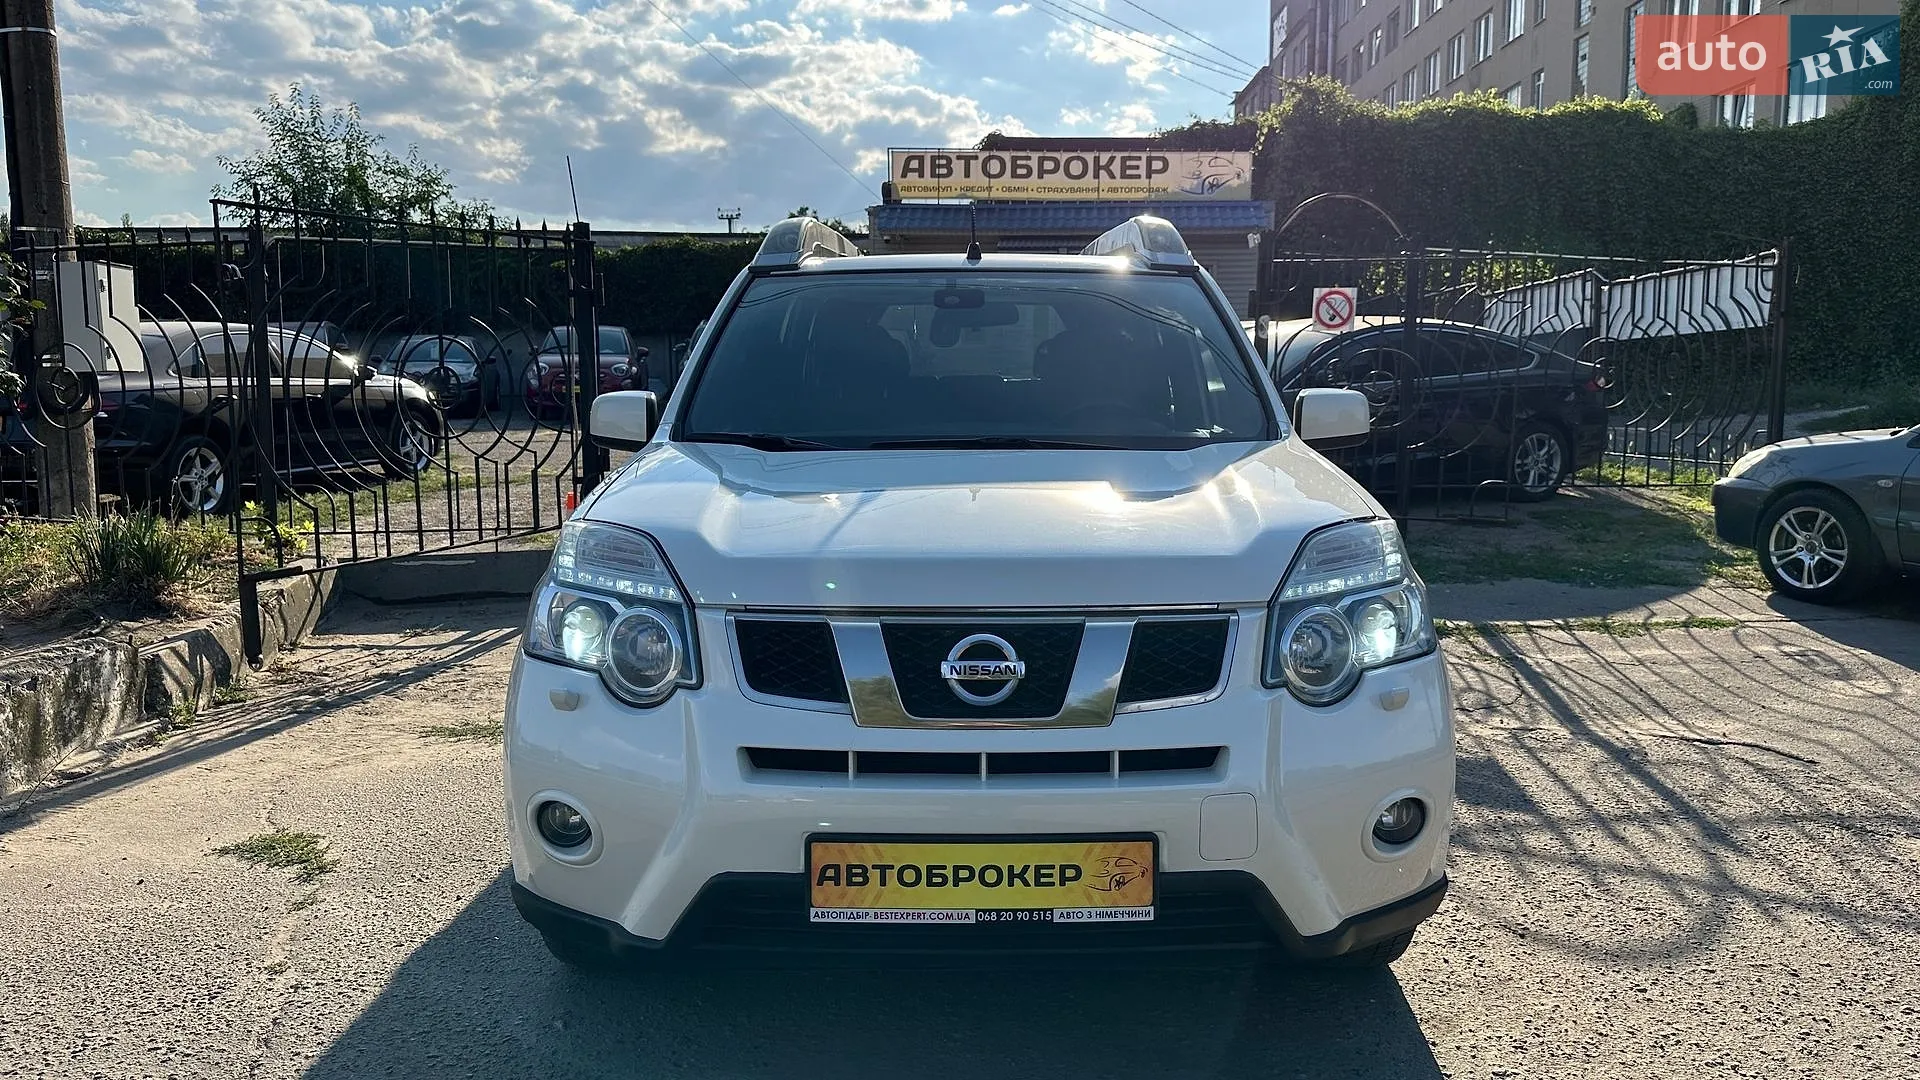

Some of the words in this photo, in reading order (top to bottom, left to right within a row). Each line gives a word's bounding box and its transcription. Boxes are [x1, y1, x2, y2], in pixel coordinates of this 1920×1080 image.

[900, 154, 1170, 180] АВТОБРОКЕР
[900, 185, 952, 193] АВТОВИКУП
[959, 185, 994, 193] КРЕДИТ
[1036, 186, 1099, 194] СТРАХУВАННЯ
[1106, 186, 1169, 194] АВТОПРОДАЖ
[949, 664, 1017, 676] NISSAN
[816, 863, 1083, 888] АВТОБРОКЕР
[977, 911, 998, 921] 068
[1000, 911, 1014, 921] 20
[1016, 911, 1030, 921] 90
[1032, 911, 1052, 921] 515
[1058, 910, 1084, 920] АВТО
[1096, 909, 1151, 919] НІМЕЧЧИНИ
